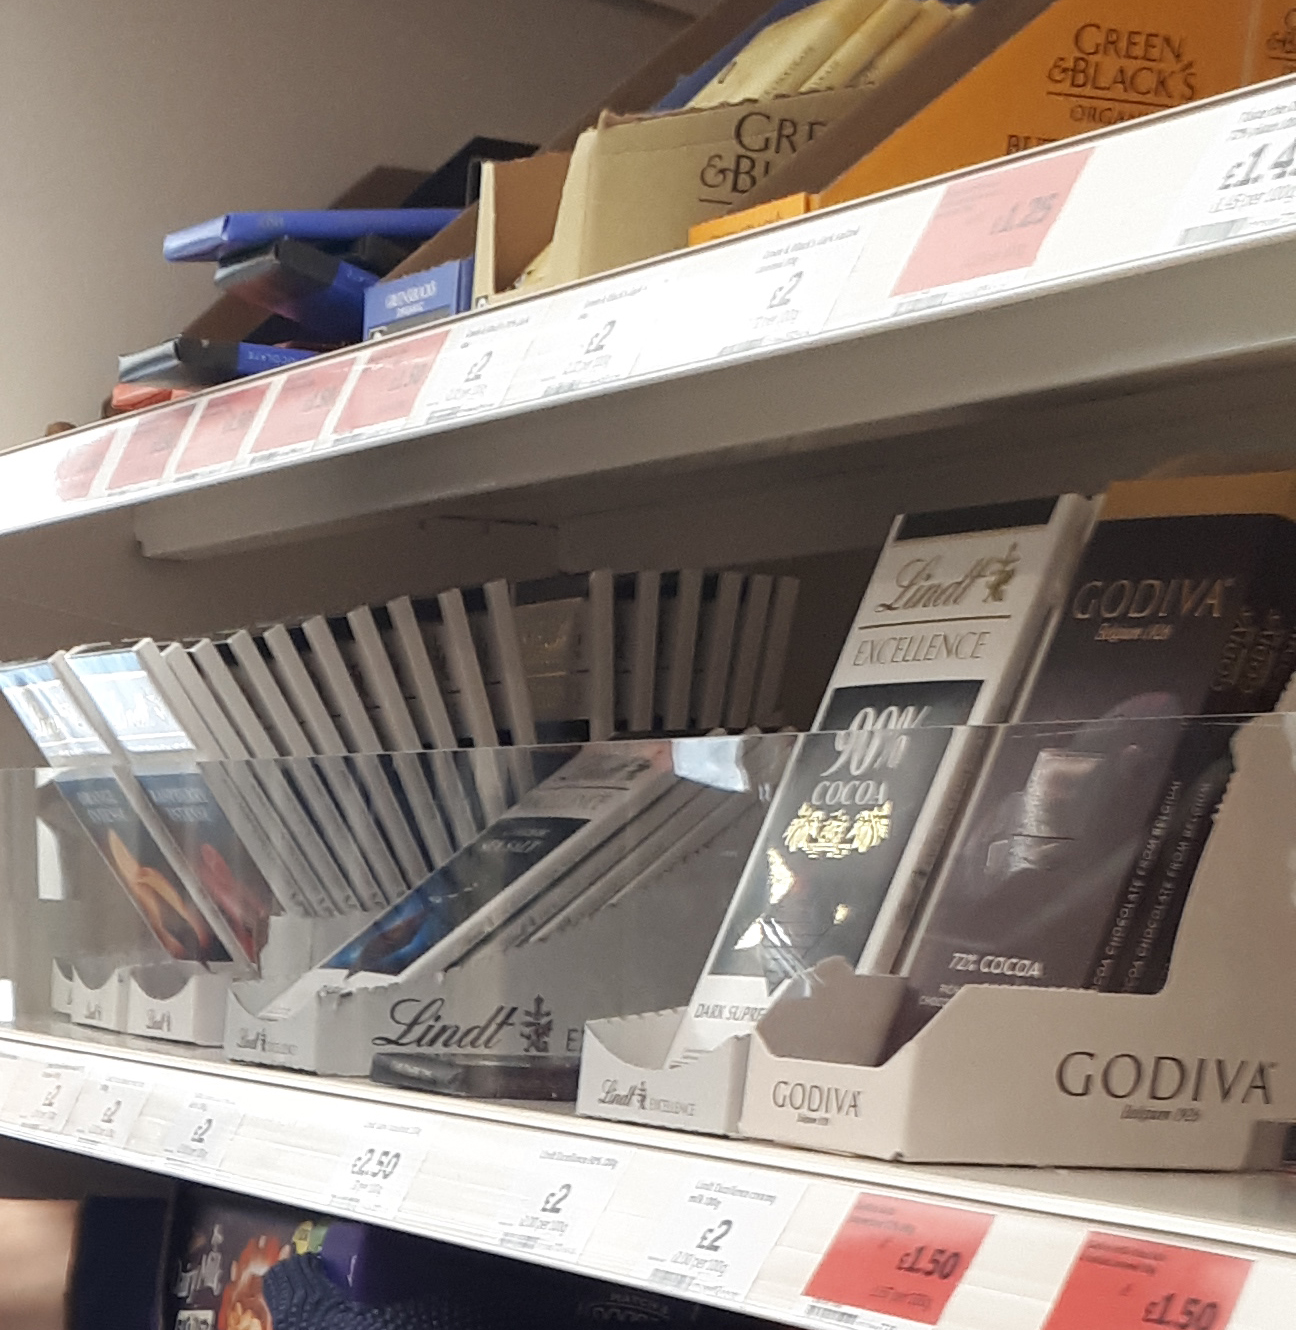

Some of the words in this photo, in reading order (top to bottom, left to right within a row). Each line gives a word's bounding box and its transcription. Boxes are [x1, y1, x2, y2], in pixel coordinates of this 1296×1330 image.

[1075, 23, 1184, 62] GREEN
[1046, 54, 1198, 101] &BLACK'S
[768, 270, 803, 309] £2
[584, 320, 617, 355] £2
[465, 351, 494, 383] £2
[874, 554, 988, 614] Lindt
[1071, 577, 1234, 621] GODIVA
[852, 630, 992, 667] EXCELLENCE
[811, 780, 890, 806] COCOA
[979, 953, 1045, 979] COCOA
[371, 998, 519, 1050] Lindt
[693, 1001, 722, 1019] DARK
[1056, 1050, 1280, 1106] GODIVA
[772, 1079, 863, 1118] GODIVA
[351, 1147, 401, 1181] £2.50
[541, 1182, 572, 1214] £2
[695, 1218, 734, 1253] £2
[898, 1244, 962, 1281] £1.50
